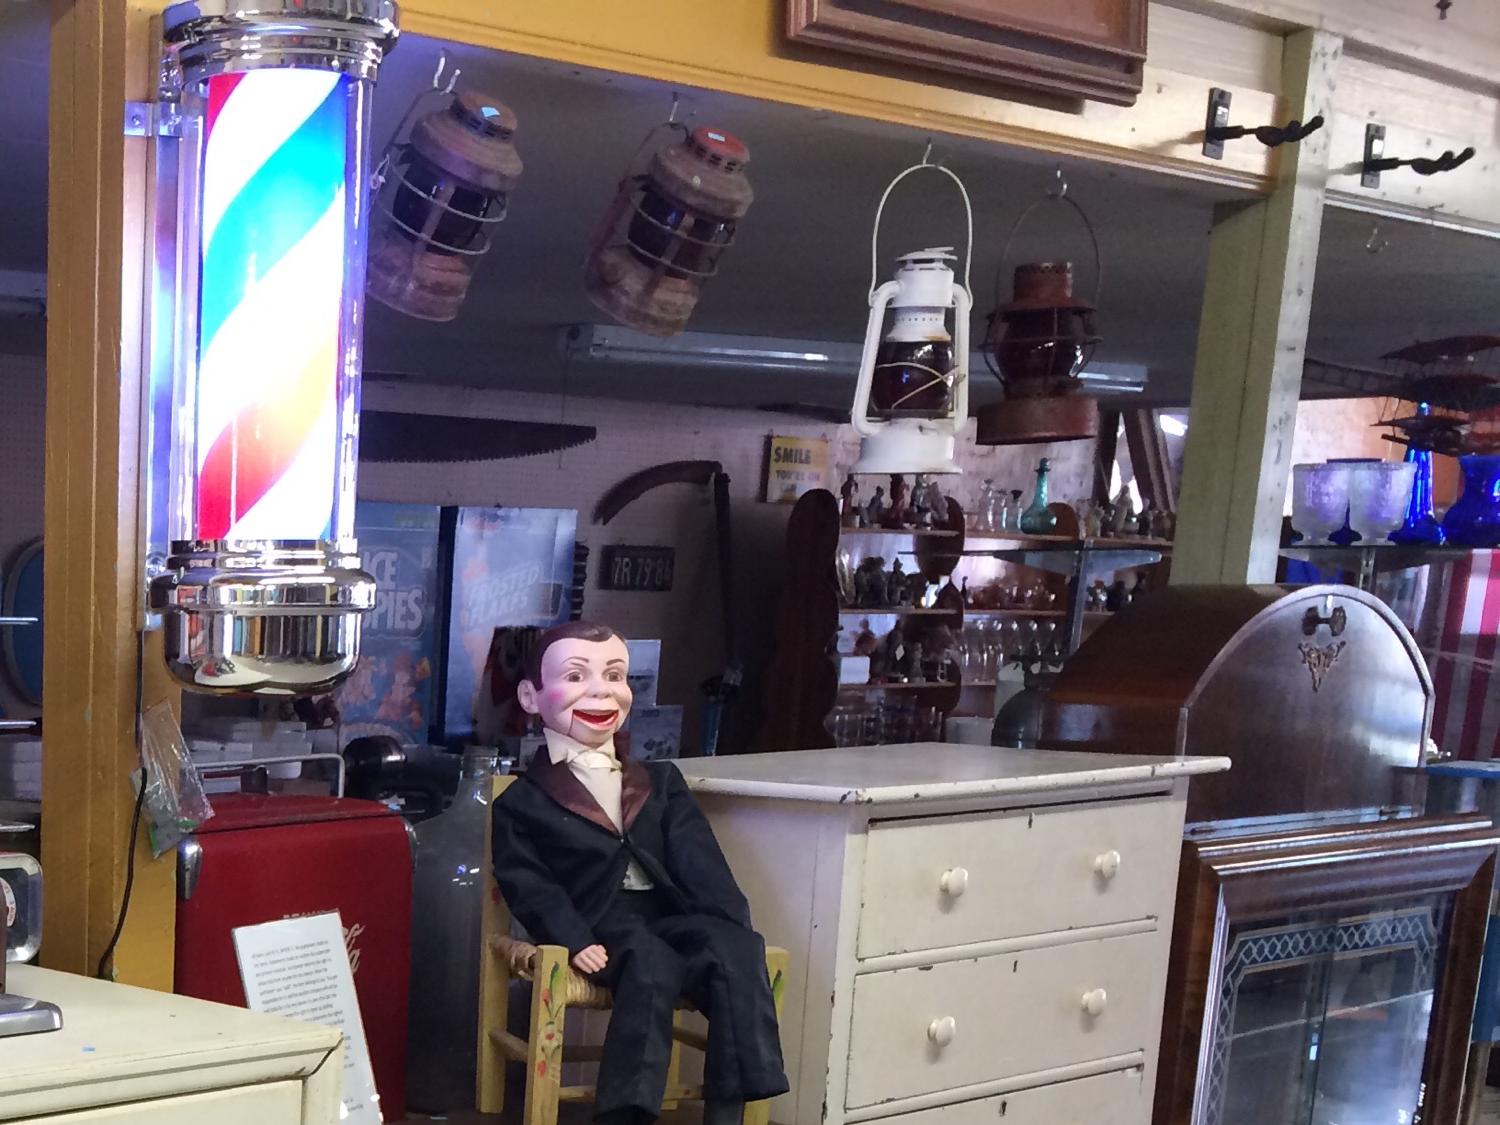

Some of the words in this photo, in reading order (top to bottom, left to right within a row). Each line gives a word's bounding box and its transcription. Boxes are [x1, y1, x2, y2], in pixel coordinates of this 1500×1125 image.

[774, 446, 811, 464] SMILE
[468, 564, 540, 607] FROSTED
[468, 588, 529, 628] FLAKES
